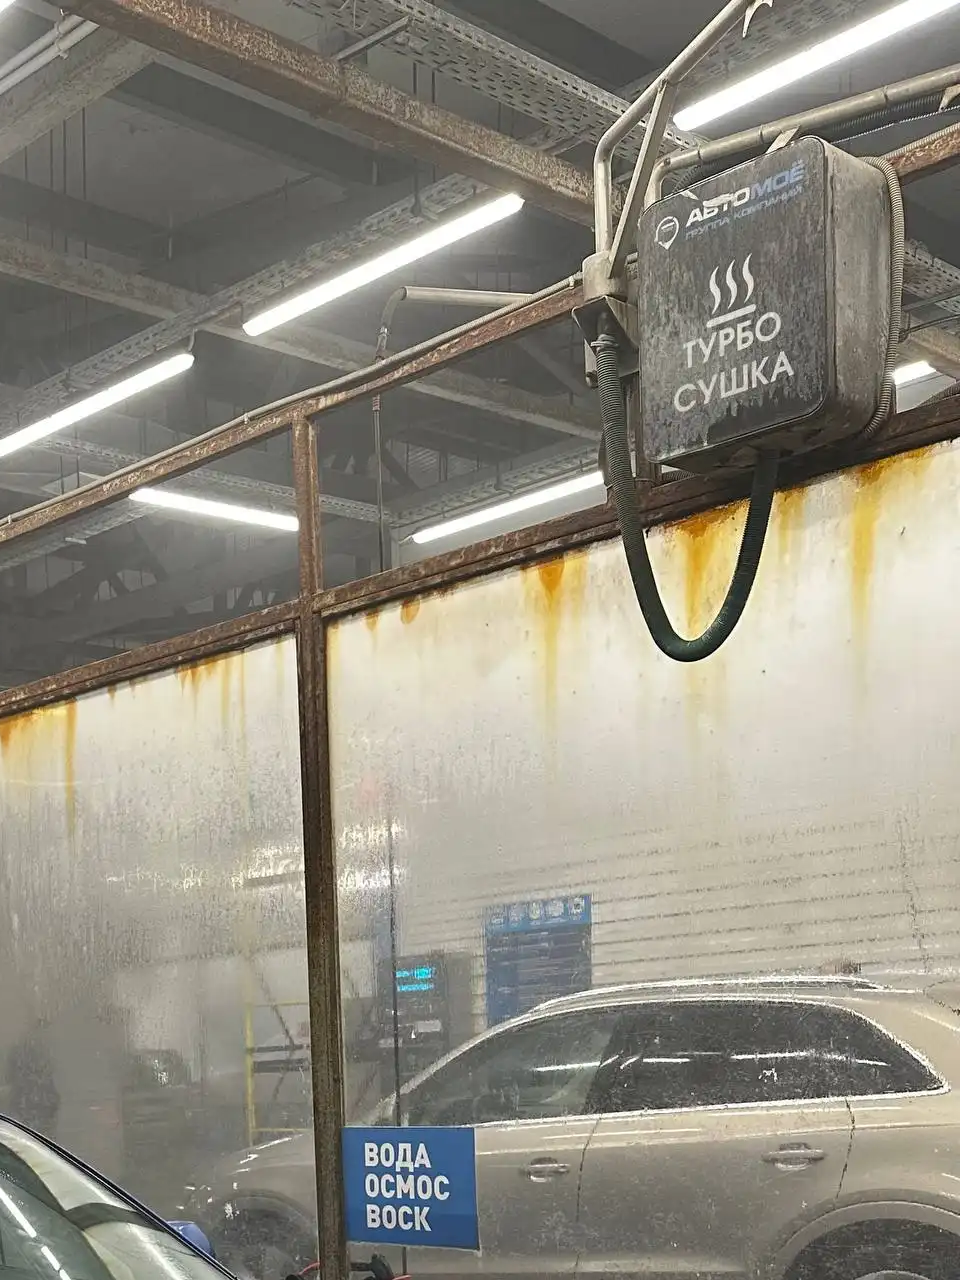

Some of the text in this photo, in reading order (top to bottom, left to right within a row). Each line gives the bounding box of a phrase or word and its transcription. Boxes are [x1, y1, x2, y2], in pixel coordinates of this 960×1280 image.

[682, 311, 781, 368] ТУРБО
[673, 350, 795, 412] СУШКА
[364, 1142, 432, 1172] ВОДА
[365, 1174, 450, 1201] ОСМОС
[365, 1203, 432, 1232] ВОСК
